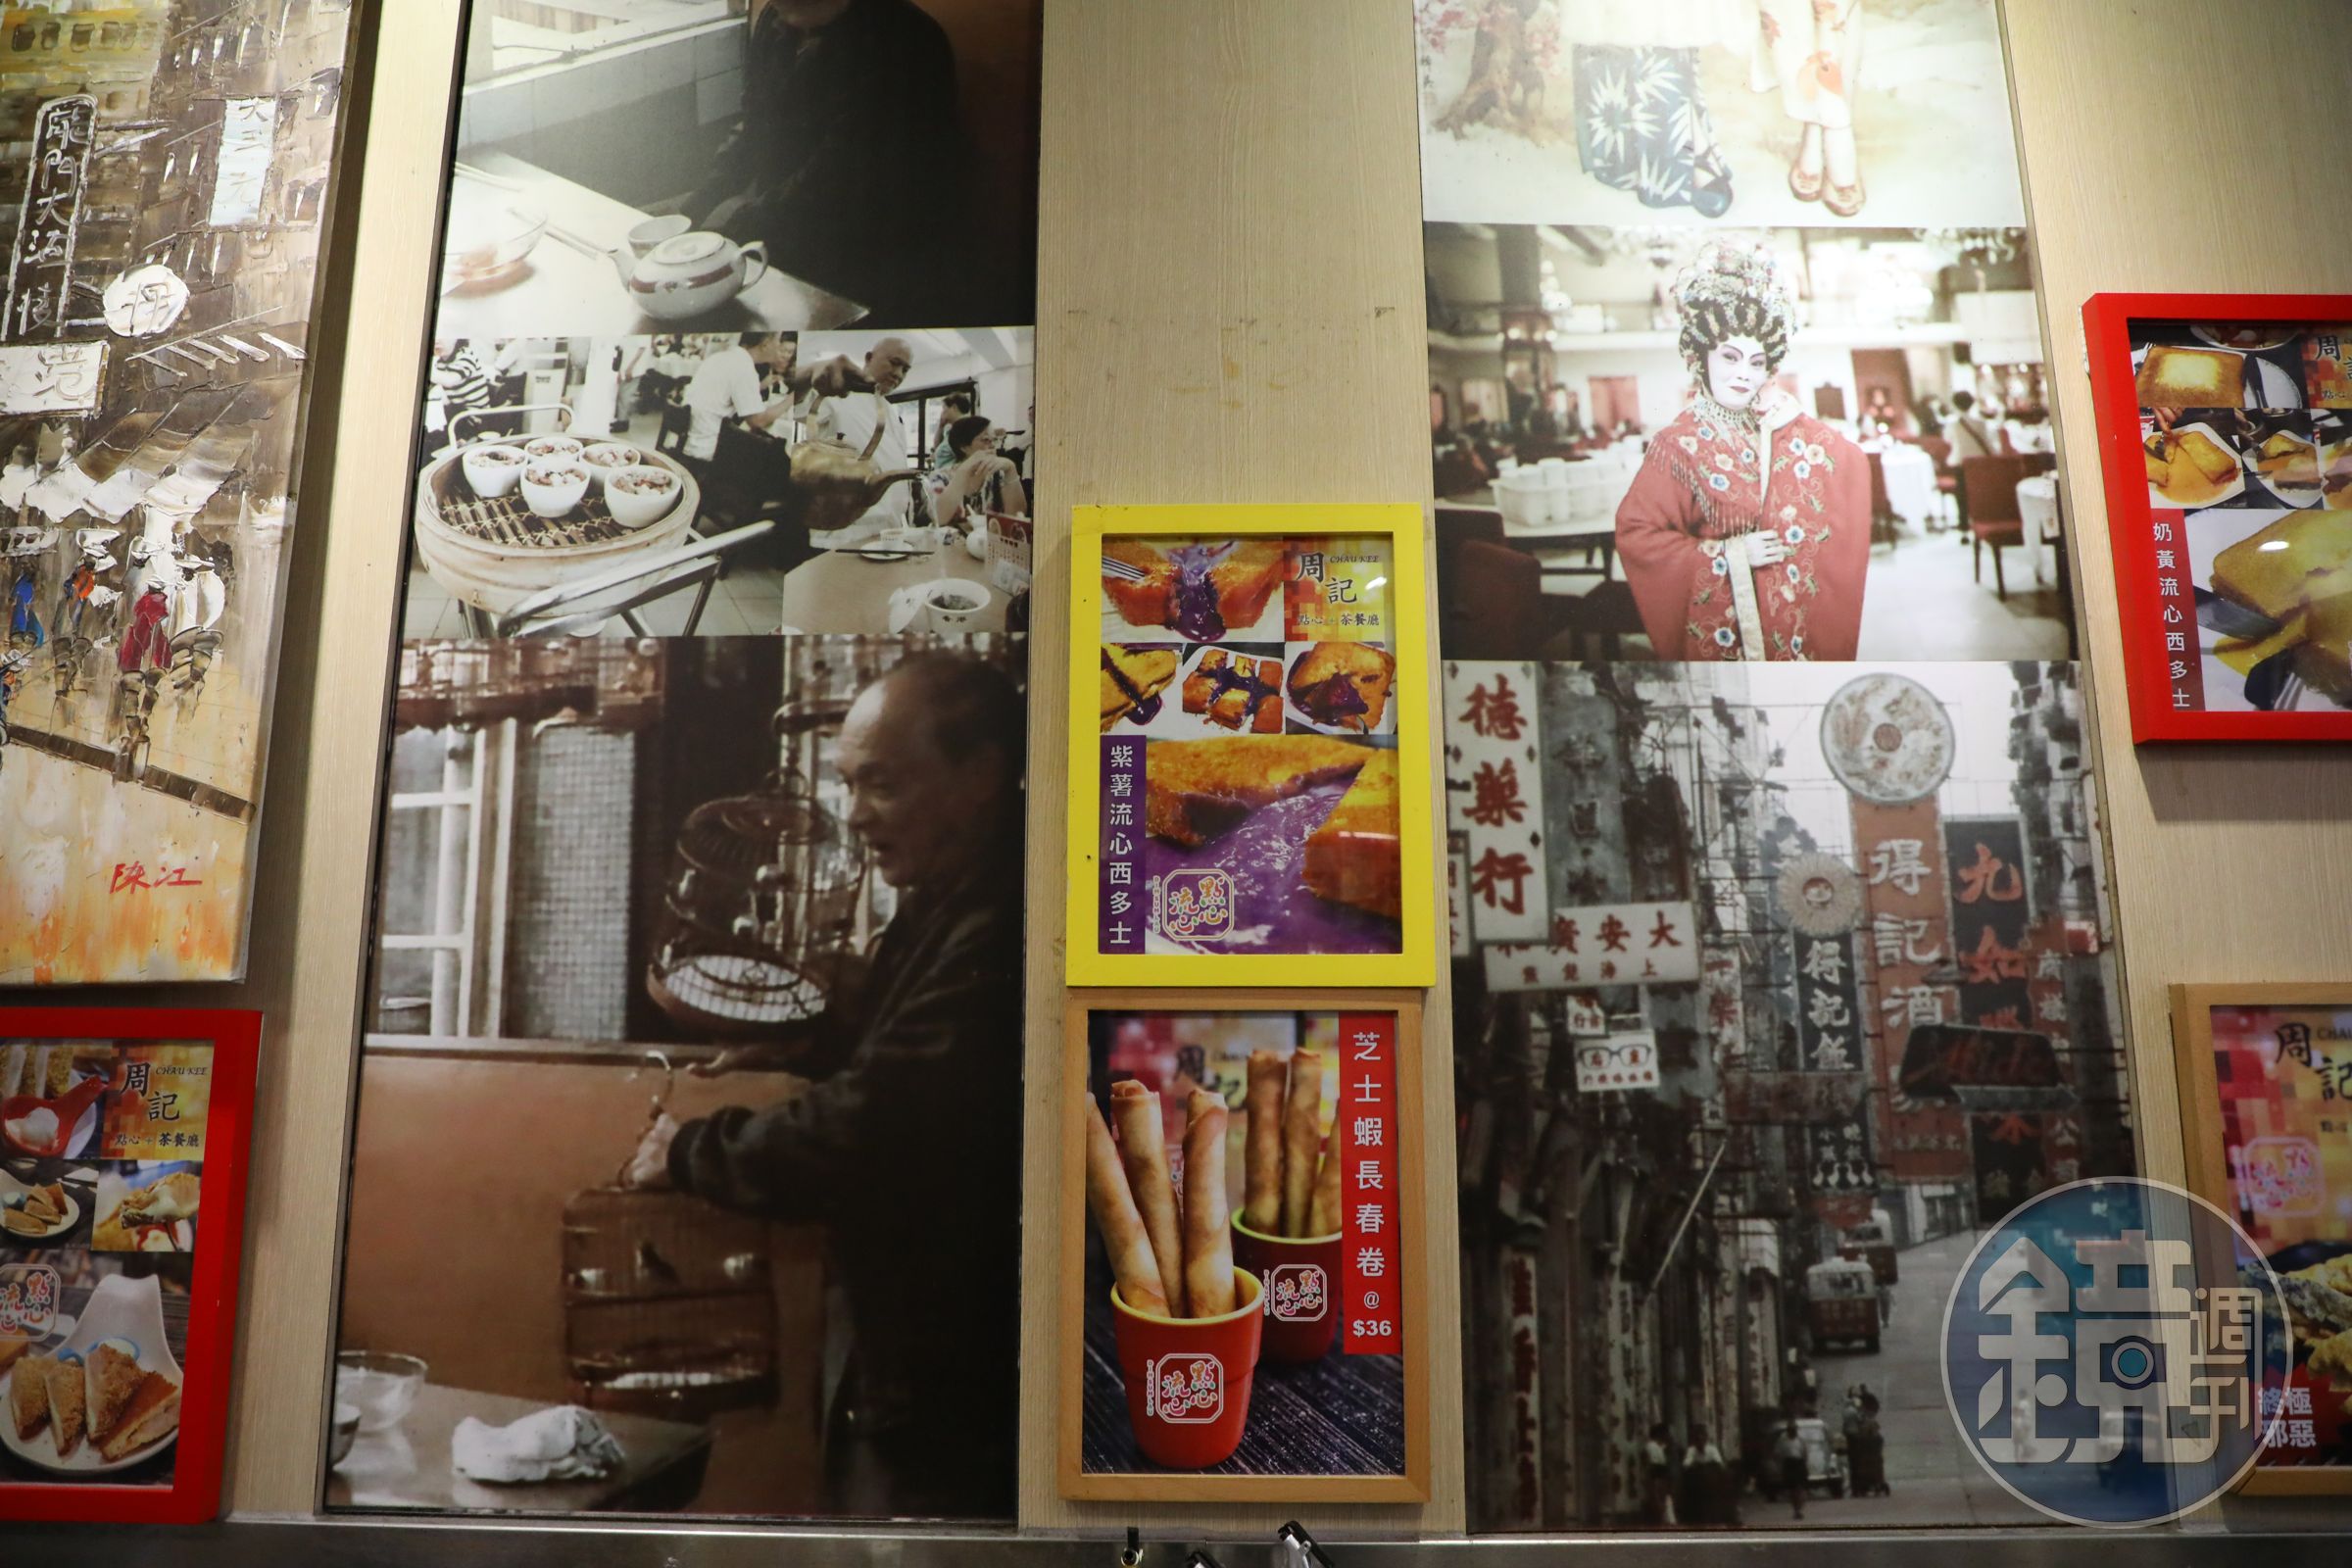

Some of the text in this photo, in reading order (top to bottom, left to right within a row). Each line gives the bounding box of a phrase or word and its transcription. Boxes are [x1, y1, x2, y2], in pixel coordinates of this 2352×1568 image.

[1297, 552, 1357, 605] 周記
[1330, 555, 1380, 564] CHAU KEE
[2152, 521, 2190, 709] 奶黃流心西多士
[1108, 745, 1133, 945] 紫薯流心西多士
[120, 1061, 180, 1122] 周記
[155, 1066, 208, 1076] CHAU KEE
[1352, 1032, 1385, 1277] 芝士蝦長春卷
[1352, 1319, 1393, 1337] $36
